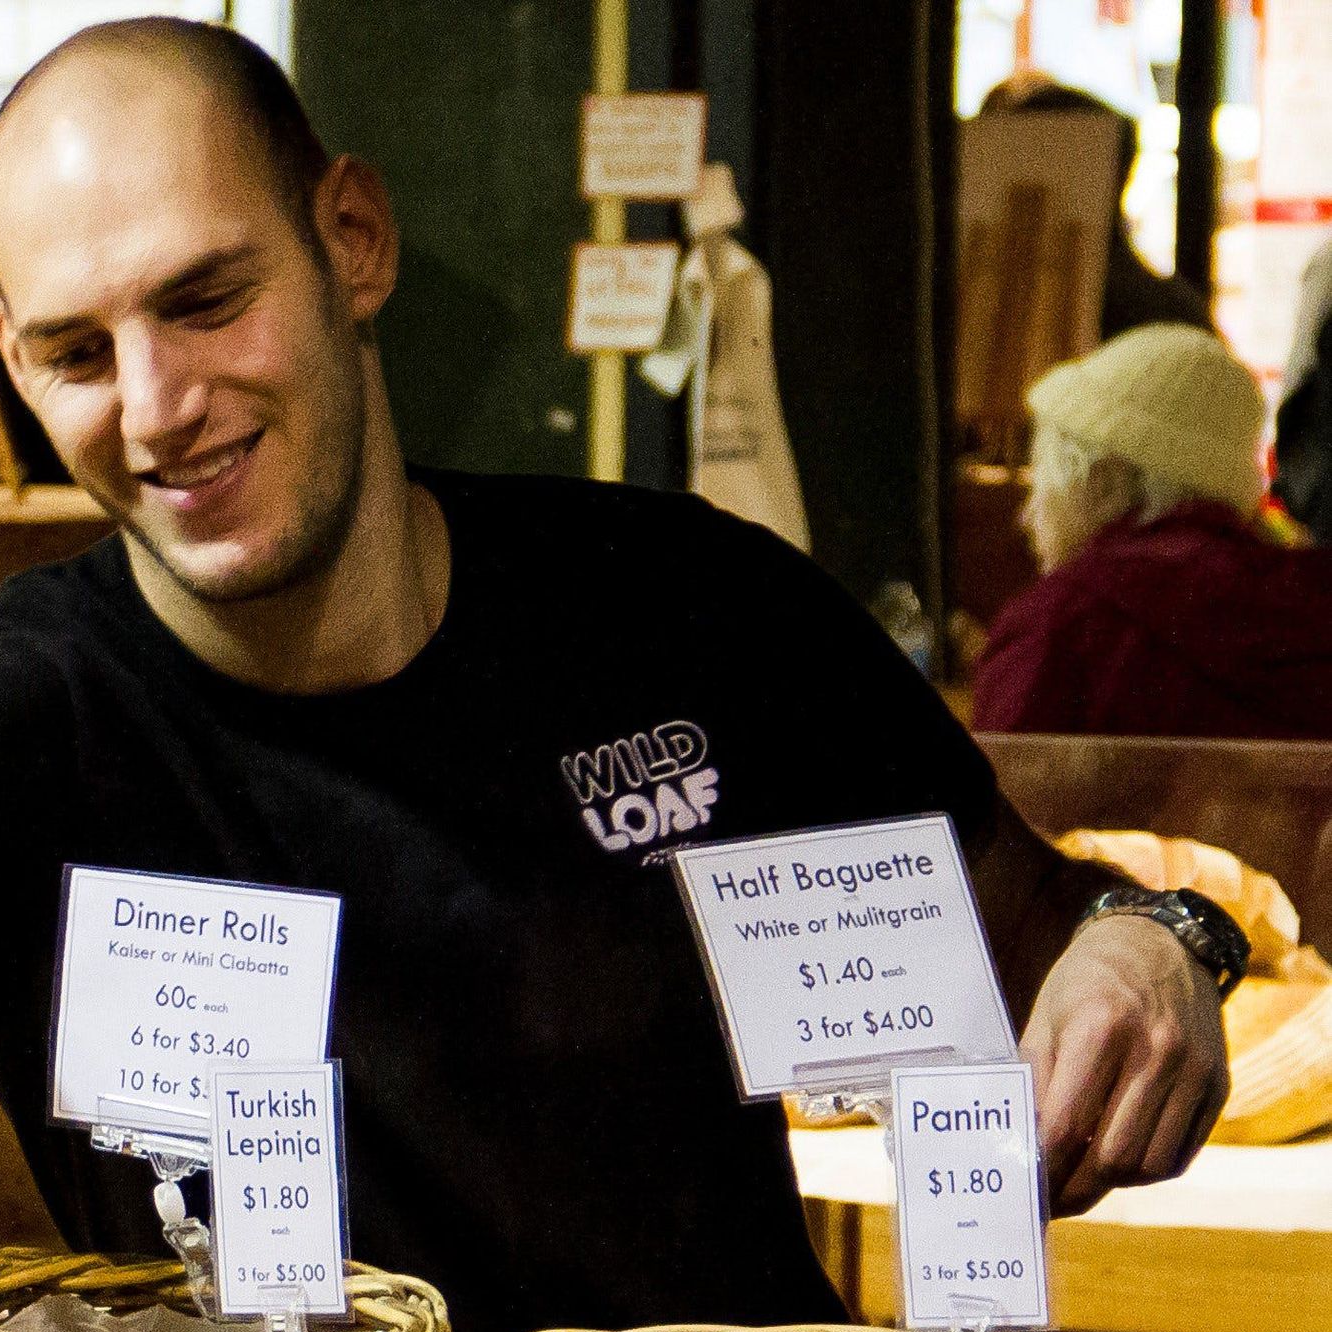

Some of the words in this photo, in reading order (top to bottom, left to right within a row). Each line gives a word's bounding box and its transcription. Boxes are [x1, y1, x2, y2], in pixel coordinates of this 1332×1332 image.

[560, 720, 708, 805] WILD
[582, 767, 719, 852] LOAF
[711, 864, 781, 902] Half
[791, 852, 935, 893] Baguette
[114, 897, 210, 936] Dinner
[222, 910, 290, 946] Rolls
[734, 919, 801, 942] White
[807, 917, 828, 934] or
[837, 901, 943, 930] Mulitgrain
[108, 939, 157, 961] Kaiser
[161, 951, 177, 963] or
[182, 951, 214, 968] Mini
[219, 953, 290, 976] Ciabatta
[798, 956, 875, 991] $1.40
[880, 965, 907, 979] each
[155, 983, 199, 1010] 60c
[203, 1002, 229, 1014] each
[796, 1018, 814, 1042] 3
[821, 1015, 854, 1039] for
[863, 1004, 935, 1037] $4.00
[130, 1025, 144, 1046] 6
[152, 1027, 181, 1049] for
[189, 1031, 251, 1059] $3.40
[119, 1068, 145, 1091] 10
[152, 1071, 182, 1095] for
[225, 1088, 317, 1119] Turkish
[912, 1098, 1012, 1133] Panini
[226, 1129, 321, 1163] Lepinja
[243, 1185, 310, 1212] $1.80
[928, 1167, 1004, 1198] $1.80
[271, 1225, 291, 1236] each
[956, 1219, 979, 1229] each
[237, 1266, 246, 1283] 3
[252, 1266, 271, 1283] for
[276, 1262, 326, 1283] $5.00
[922, 1265, 932, 1281] 3
[938, 1264, 960, 1281] for
[966, 1258, 1024, 1281] $5.00
